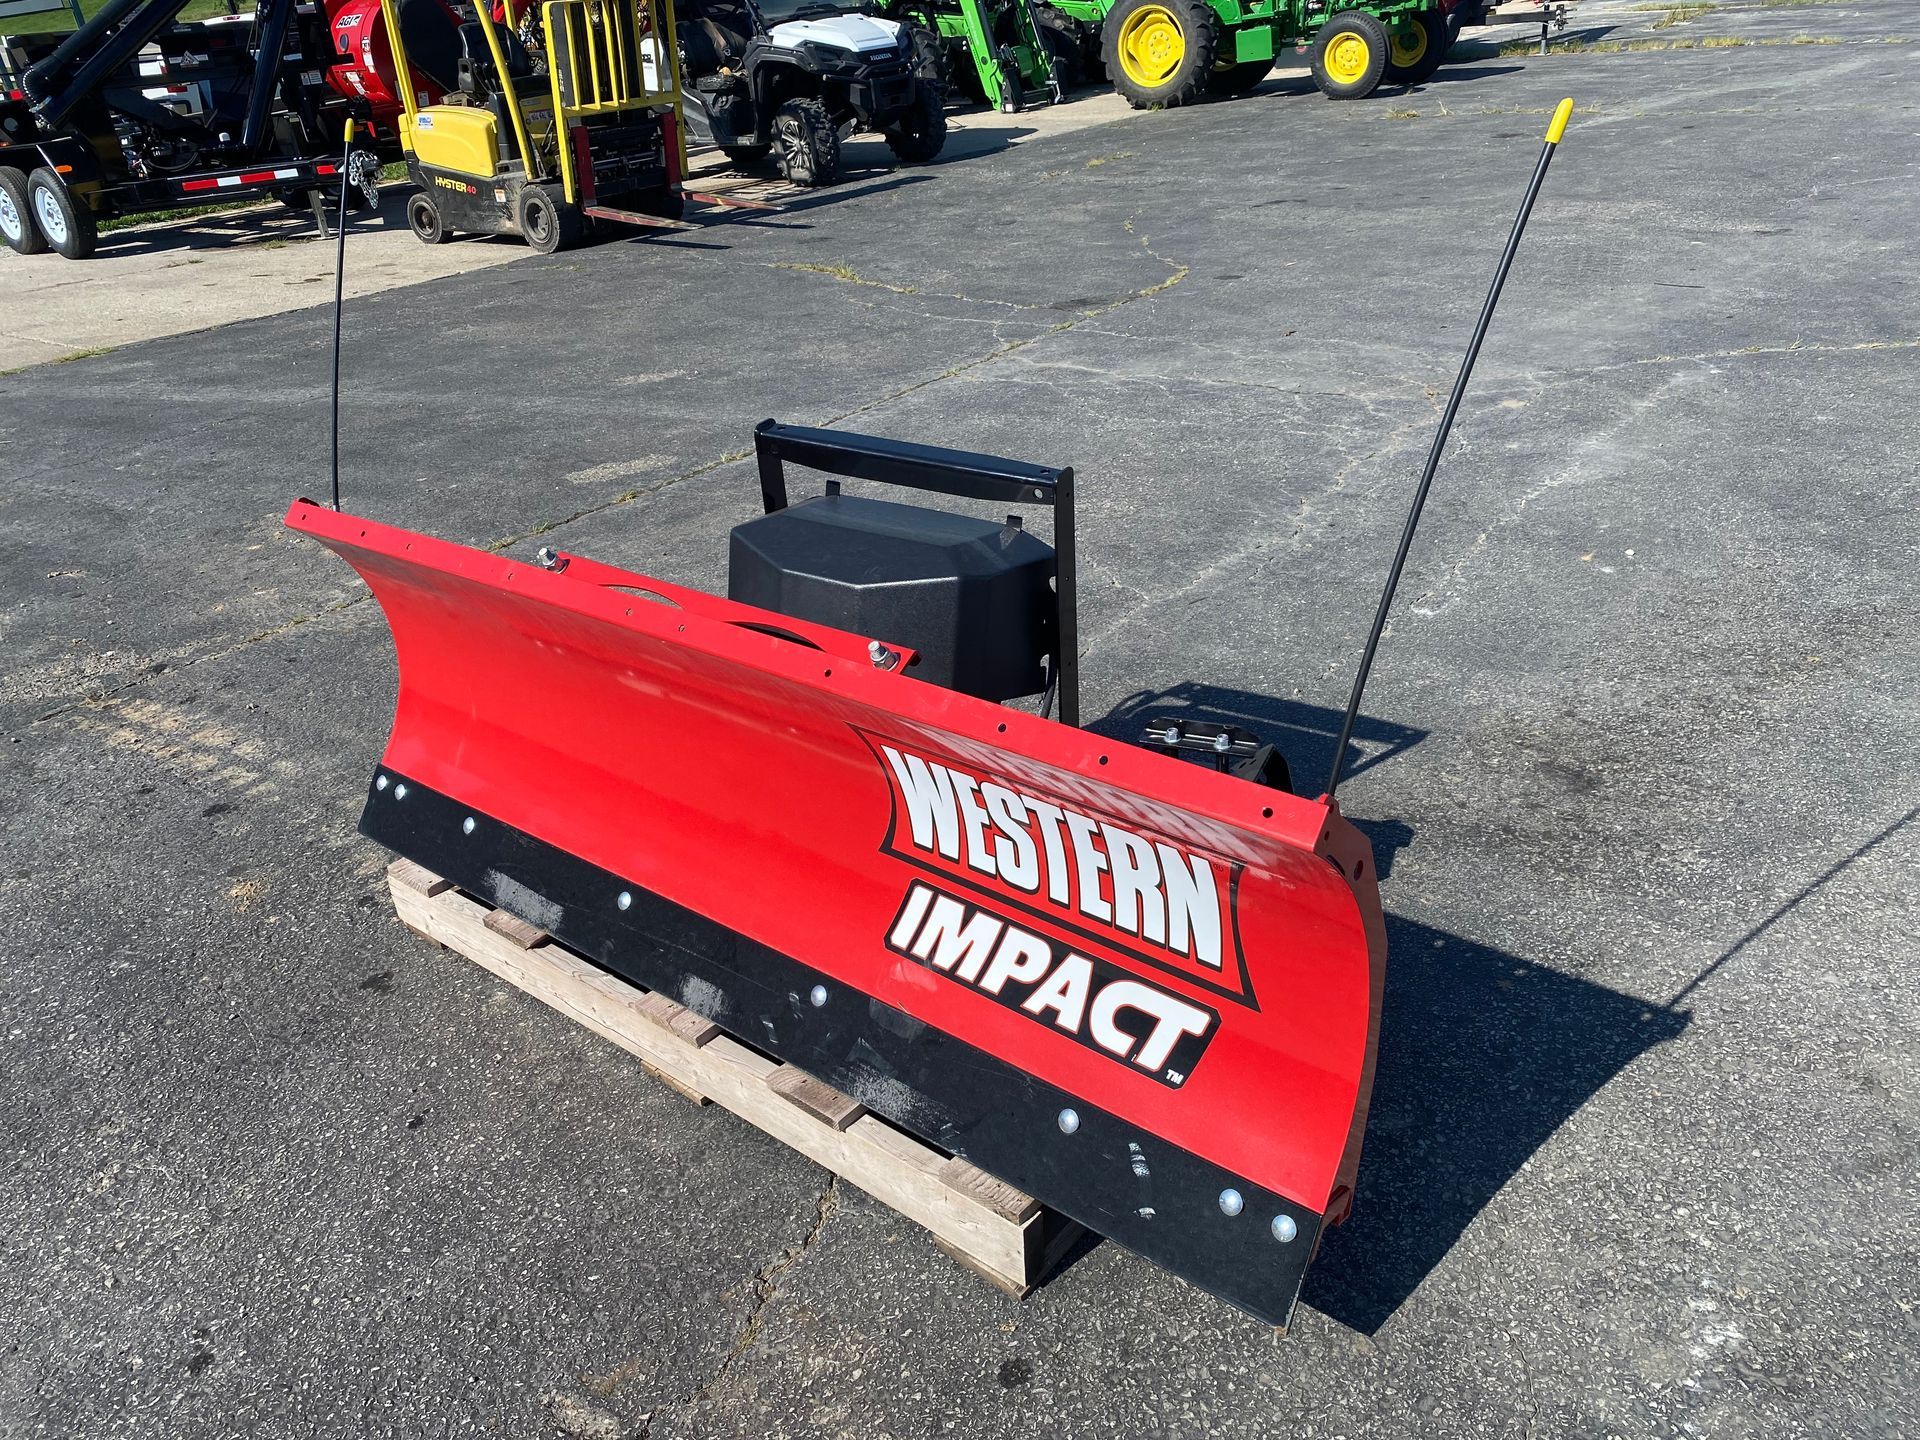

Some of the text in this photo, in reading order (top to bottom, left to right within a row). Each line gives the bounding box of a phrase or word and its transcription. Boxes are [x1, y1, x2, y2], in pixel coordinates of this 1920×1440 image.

[869, 53, 893, 61] HONDA
[435, 176, 477, 195] HYSTER 40
[880, 744, 1222, 968] WESTERN
[890, 884, 1211, 1073] IMPACT
